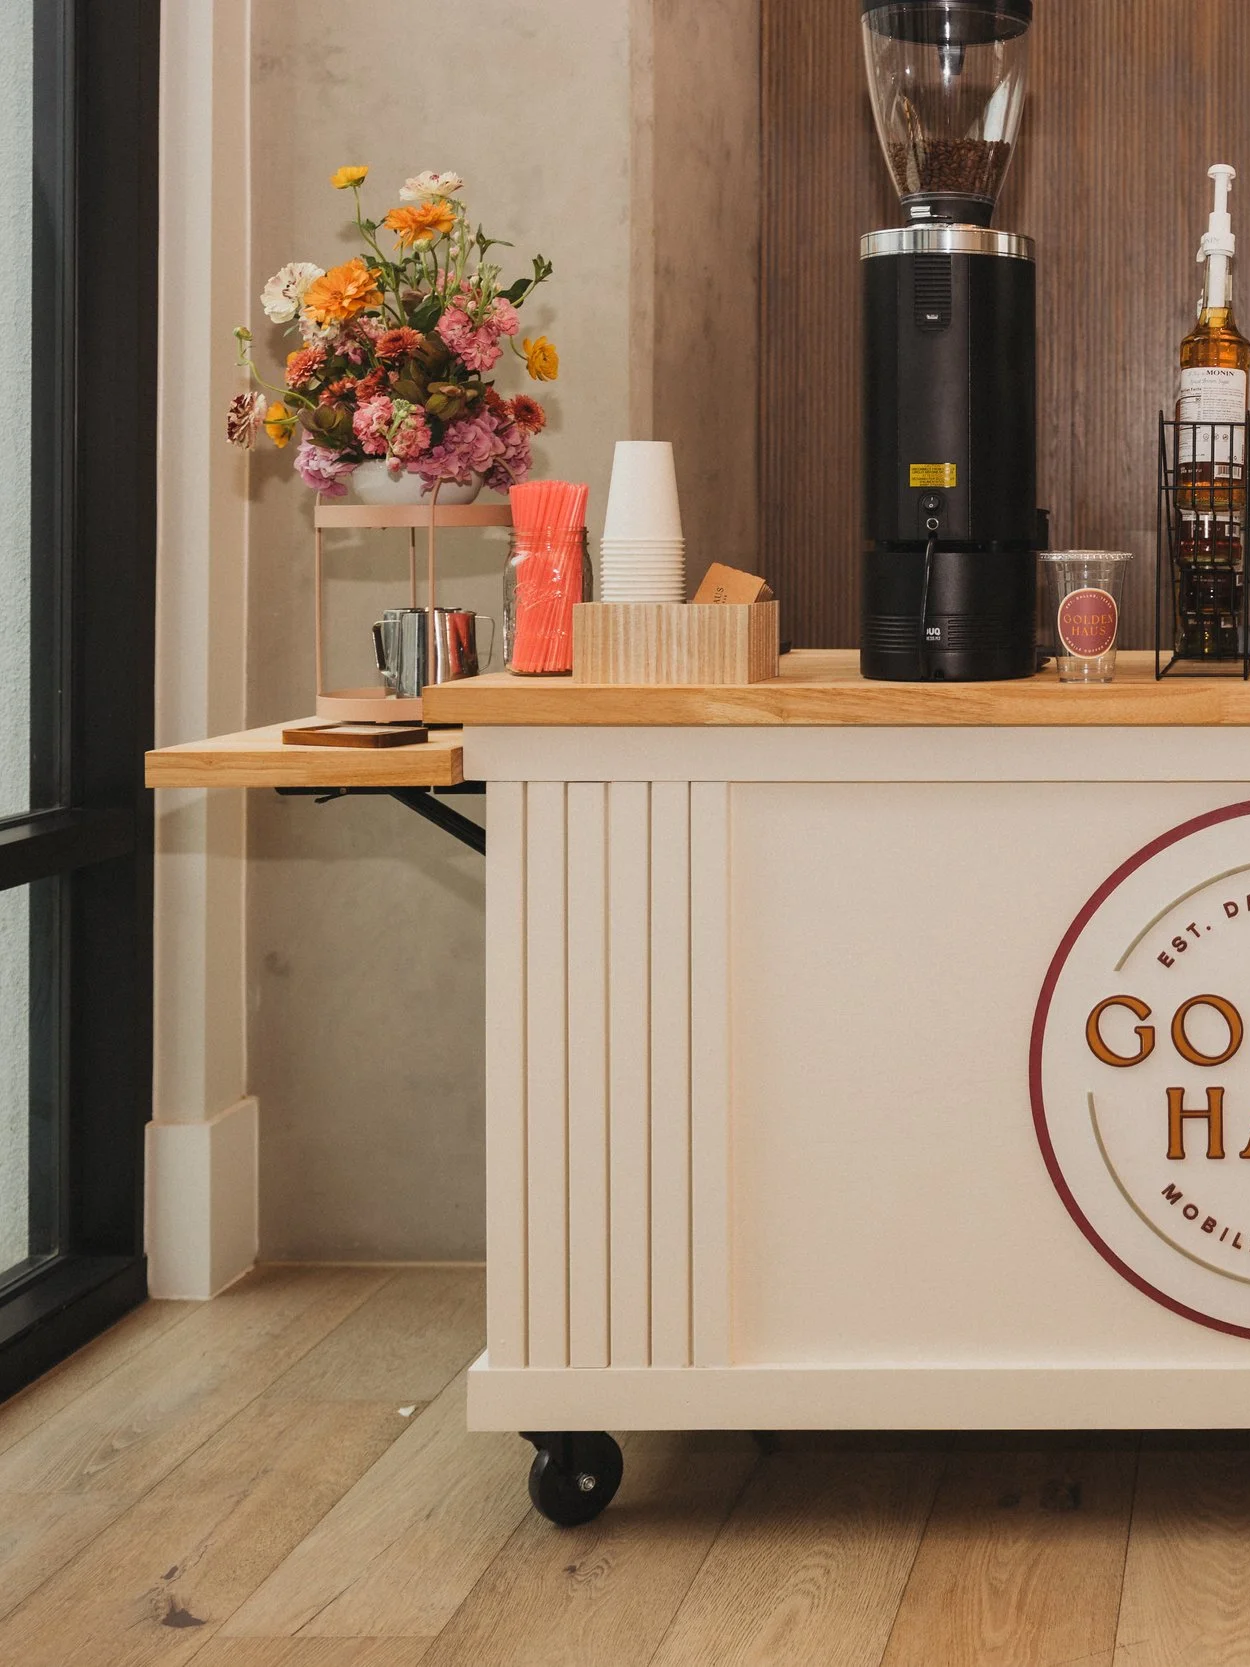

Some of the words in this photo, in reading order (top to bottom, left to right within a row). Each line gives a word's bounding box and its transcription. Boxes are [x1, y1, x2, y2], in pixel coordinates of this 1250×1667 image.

[1206, 369, 1235, 377] MONIN
[1063, 614, 1114, 625] GOLDEN
[1071, 625, 1106, 636] HAUS
[1156, 921, 1212, 969] EST.
